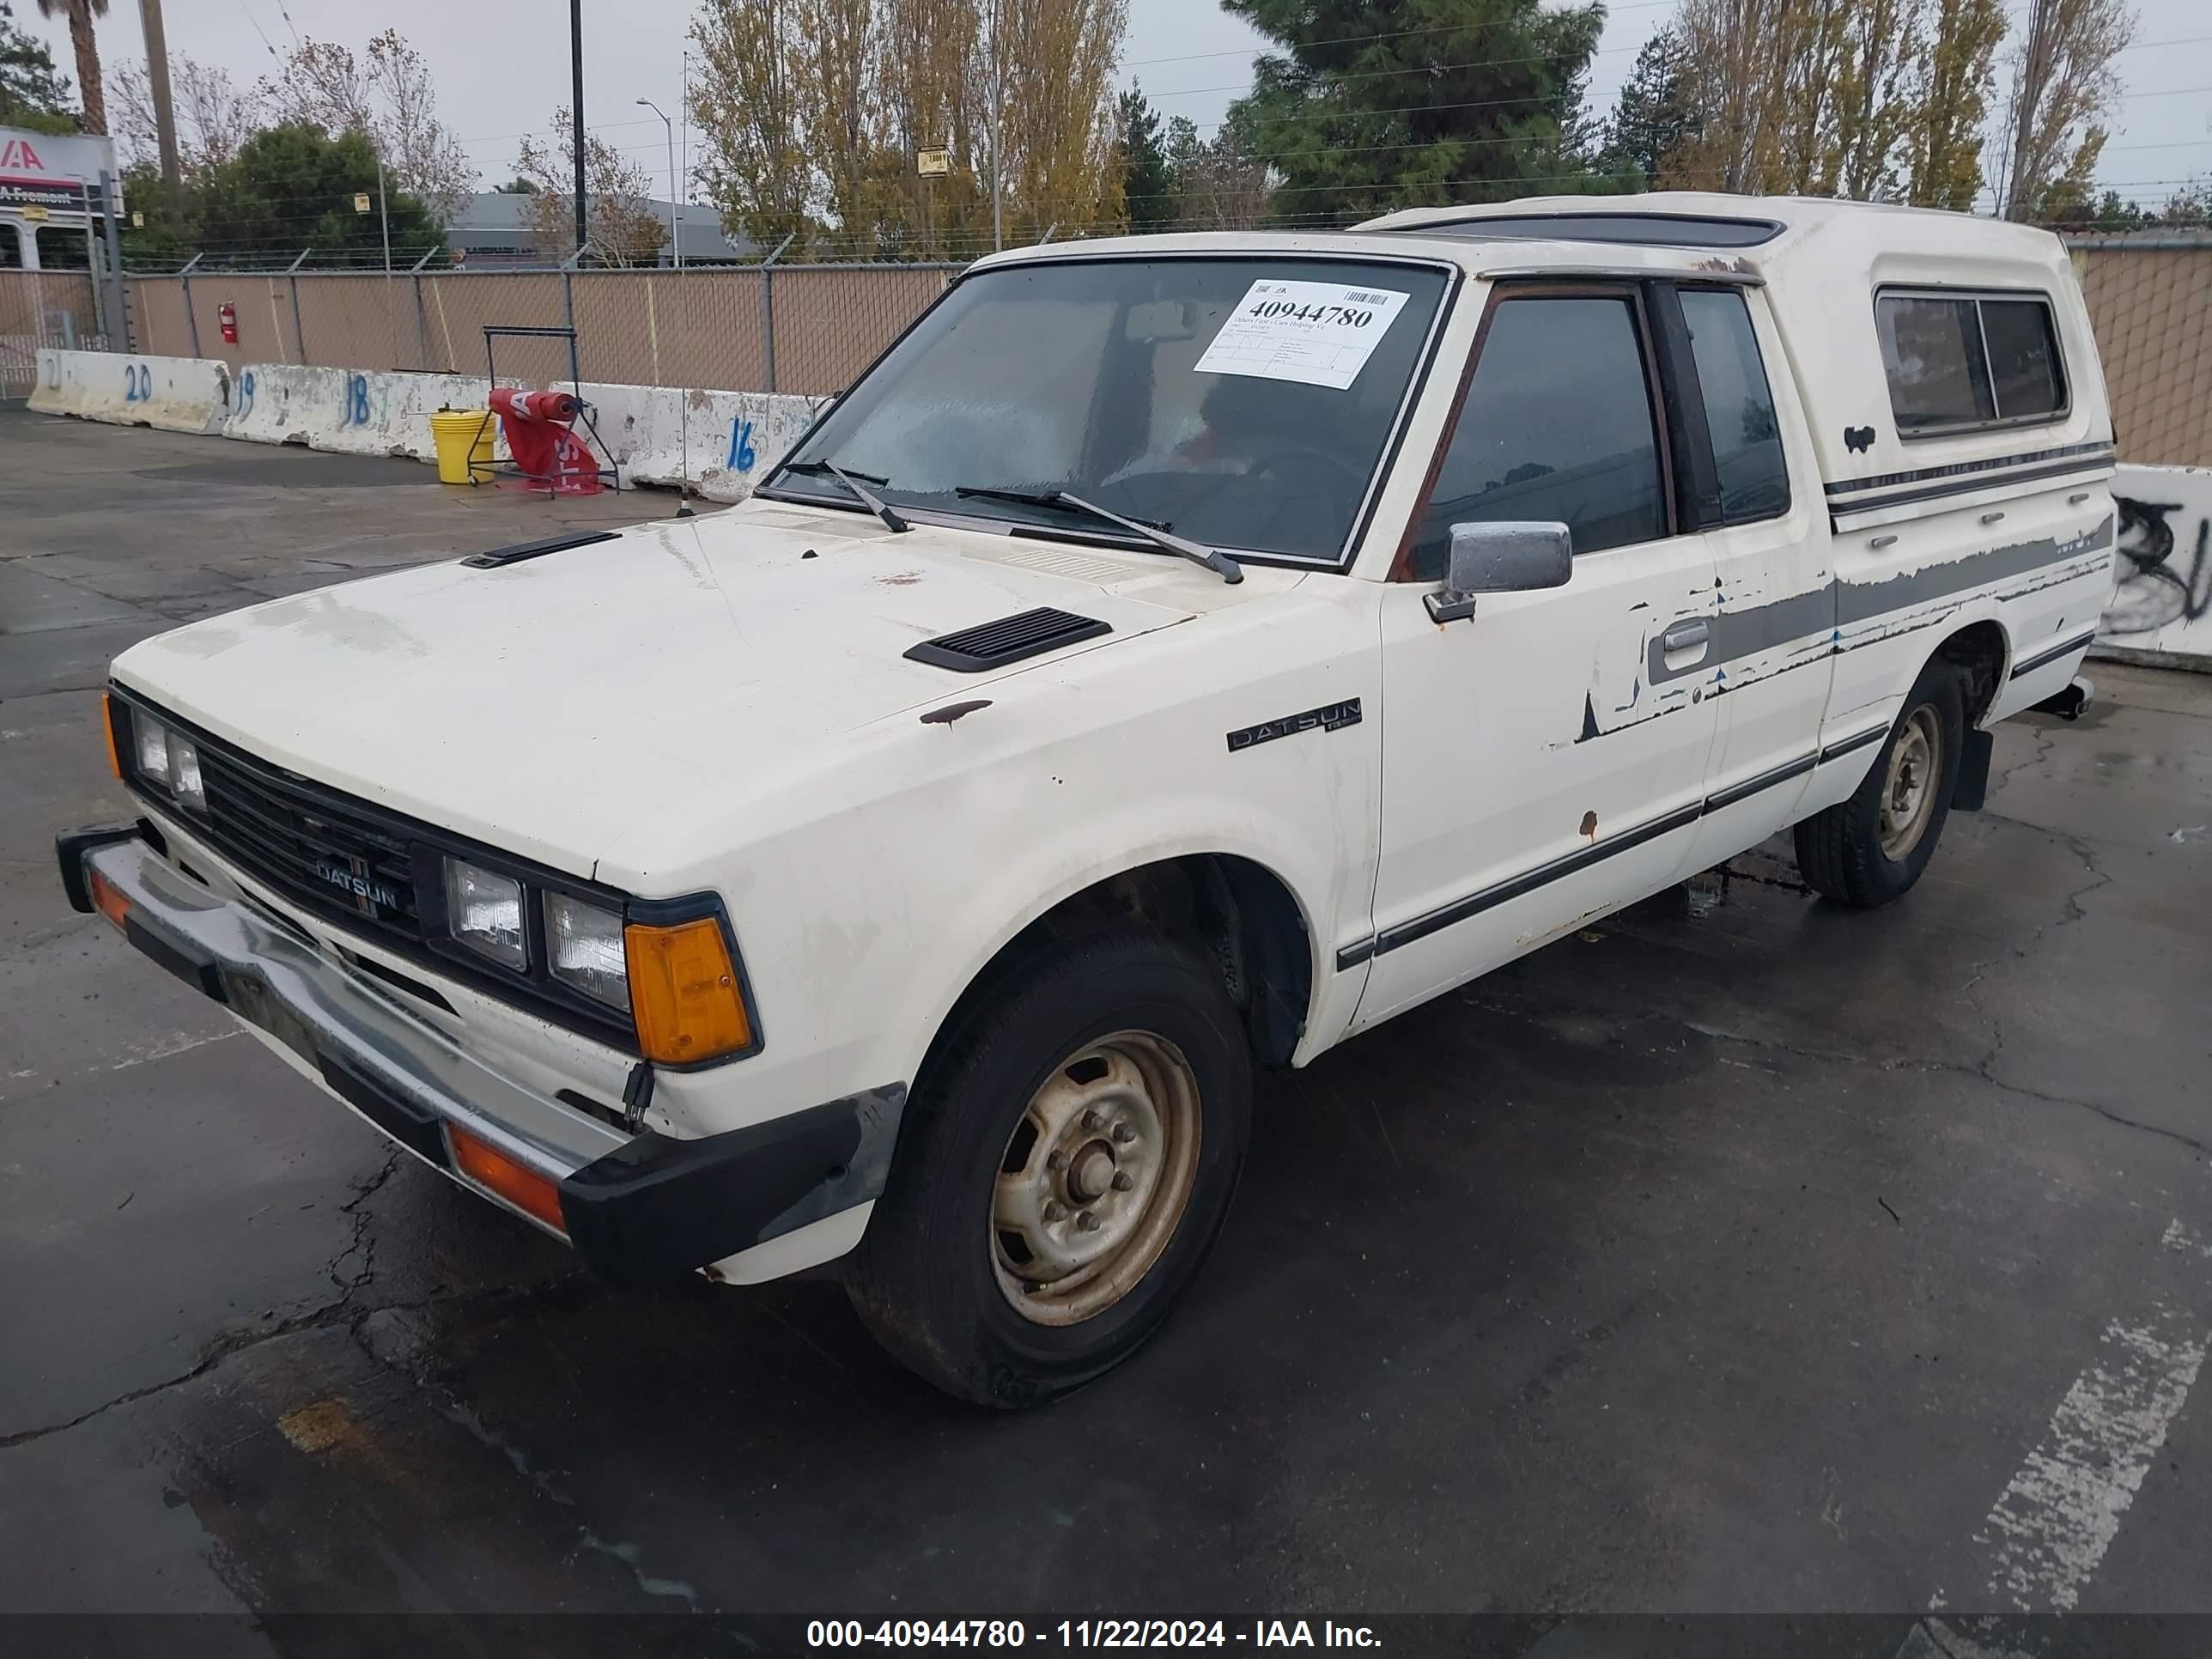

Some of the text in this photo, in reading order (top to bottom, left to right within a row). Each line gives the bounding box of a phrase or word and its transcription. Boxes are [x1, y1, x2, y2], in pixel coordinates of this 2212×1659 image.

[14, 187, 71, 204] Fremont
[1249, 301, 1373, 328] 40944780
[125, 364, 152, 402] 20
[235, 372, 255, 423] 19
[341, 372, 369, 428] 18
[728, 414, 756, 471] 16
[1233, 702, 1361, 748] DATSUN
[316, 859, 397, 908] DATSUN
